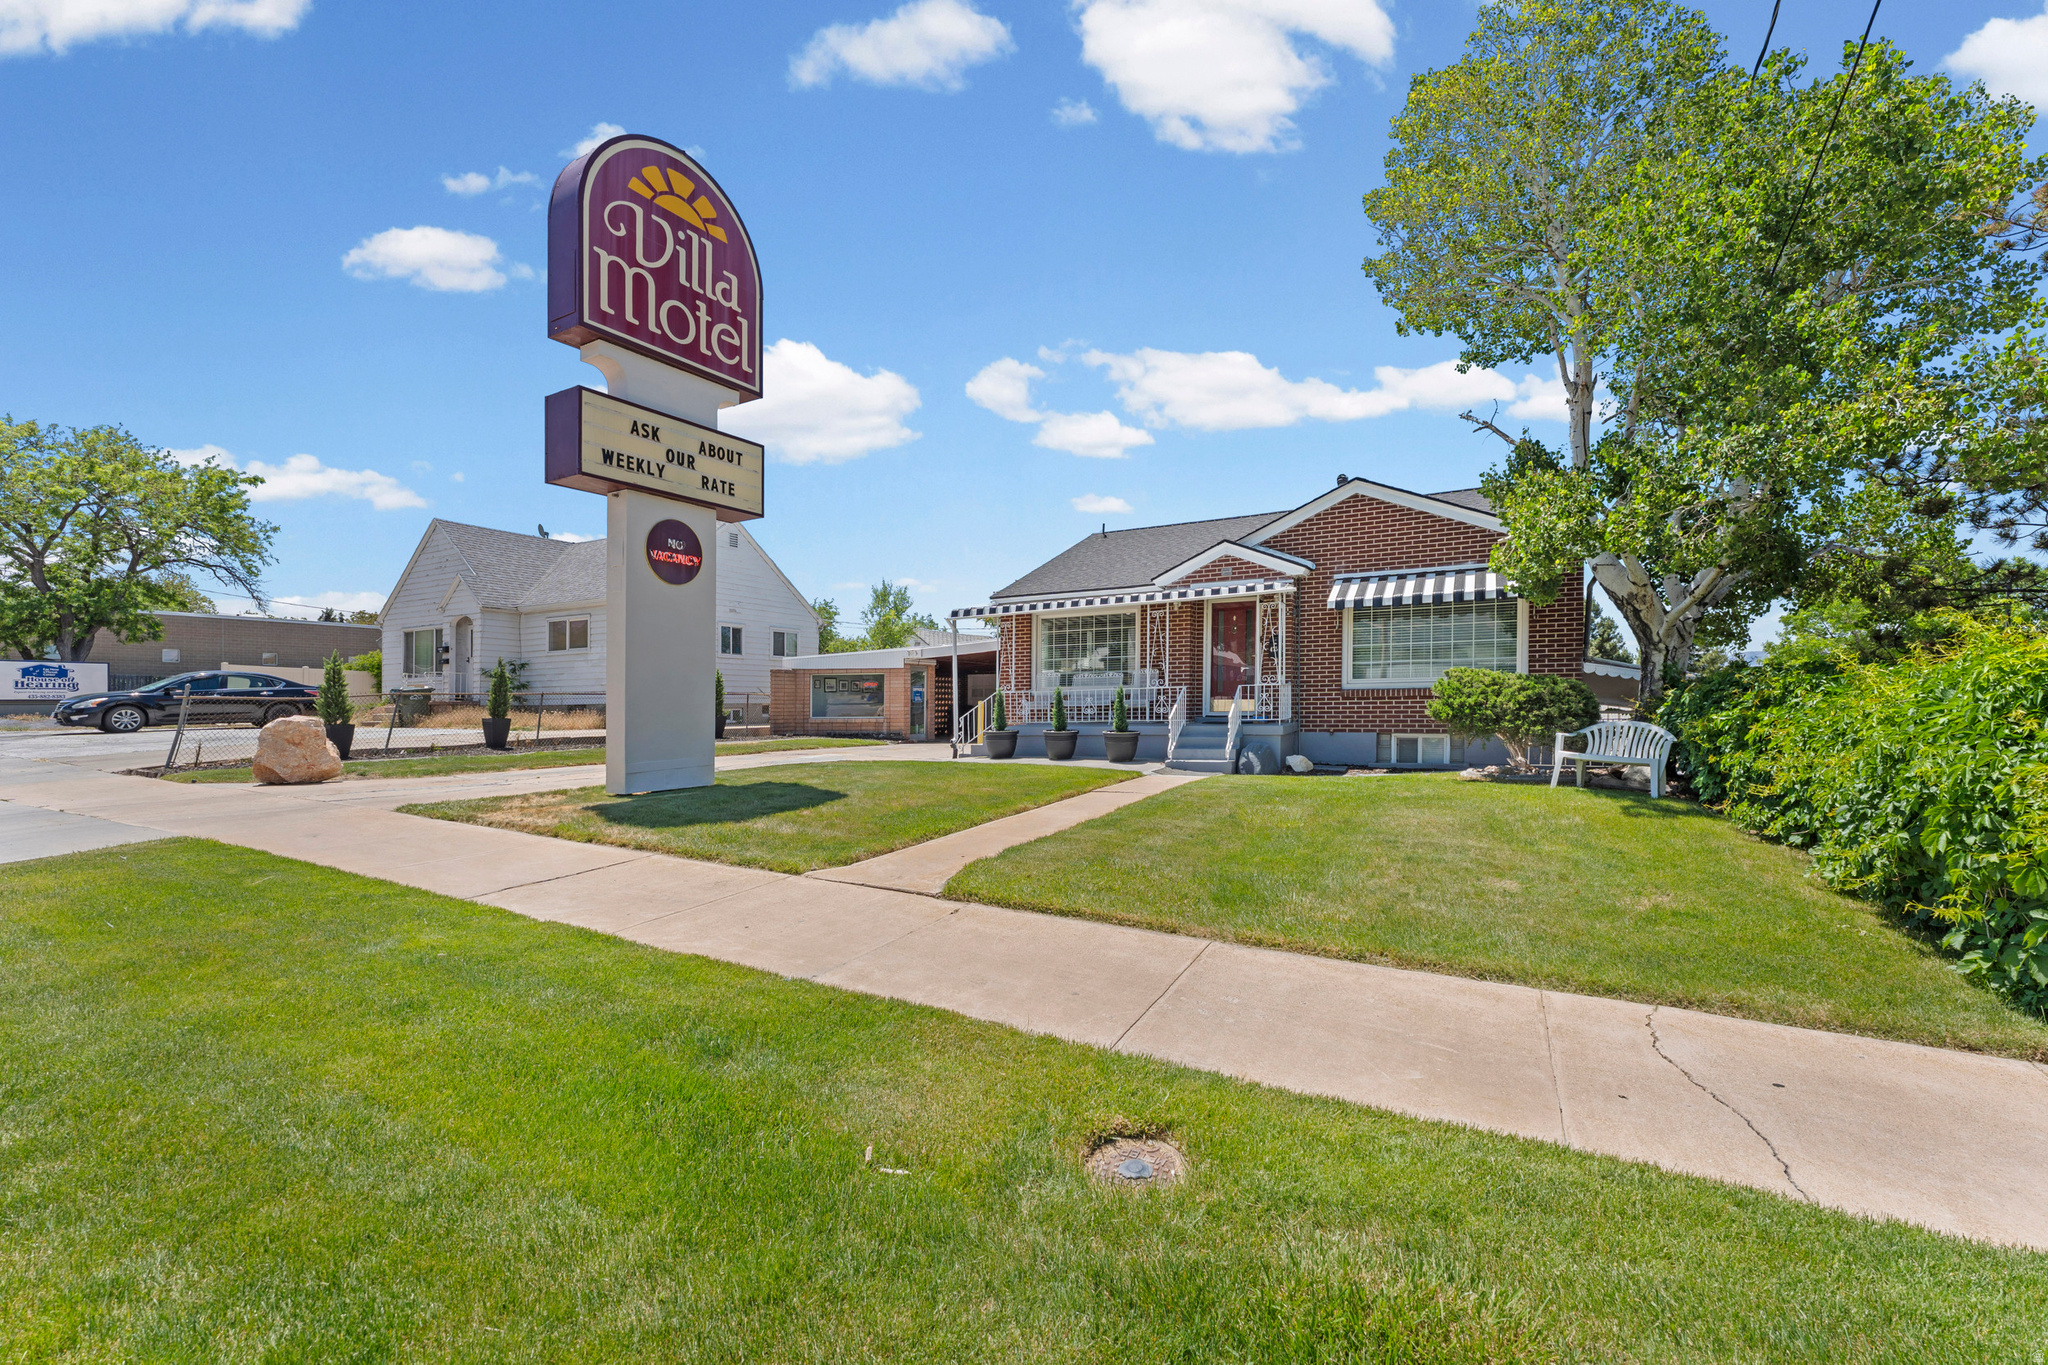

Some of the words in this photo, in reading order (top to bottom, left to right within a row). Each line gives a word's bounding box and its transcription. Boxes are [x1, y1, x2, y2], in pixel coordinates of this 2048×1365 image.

[604, 200, 742, 313] Villa
[593, 245, 753, 374] Motel
[630, 420, 661, 443] ASK
[698, 441, 743, 467] ABOUT
[665, 448, 696, 470] OUR
[602, 448, 666, 479] WEEKLY
[701, 475, 736, 498] RATE
[649, 549, 702, 567] VACANCY
[667, 538, 686, 550] NO
[14, 680, 79, 692] Hearing
